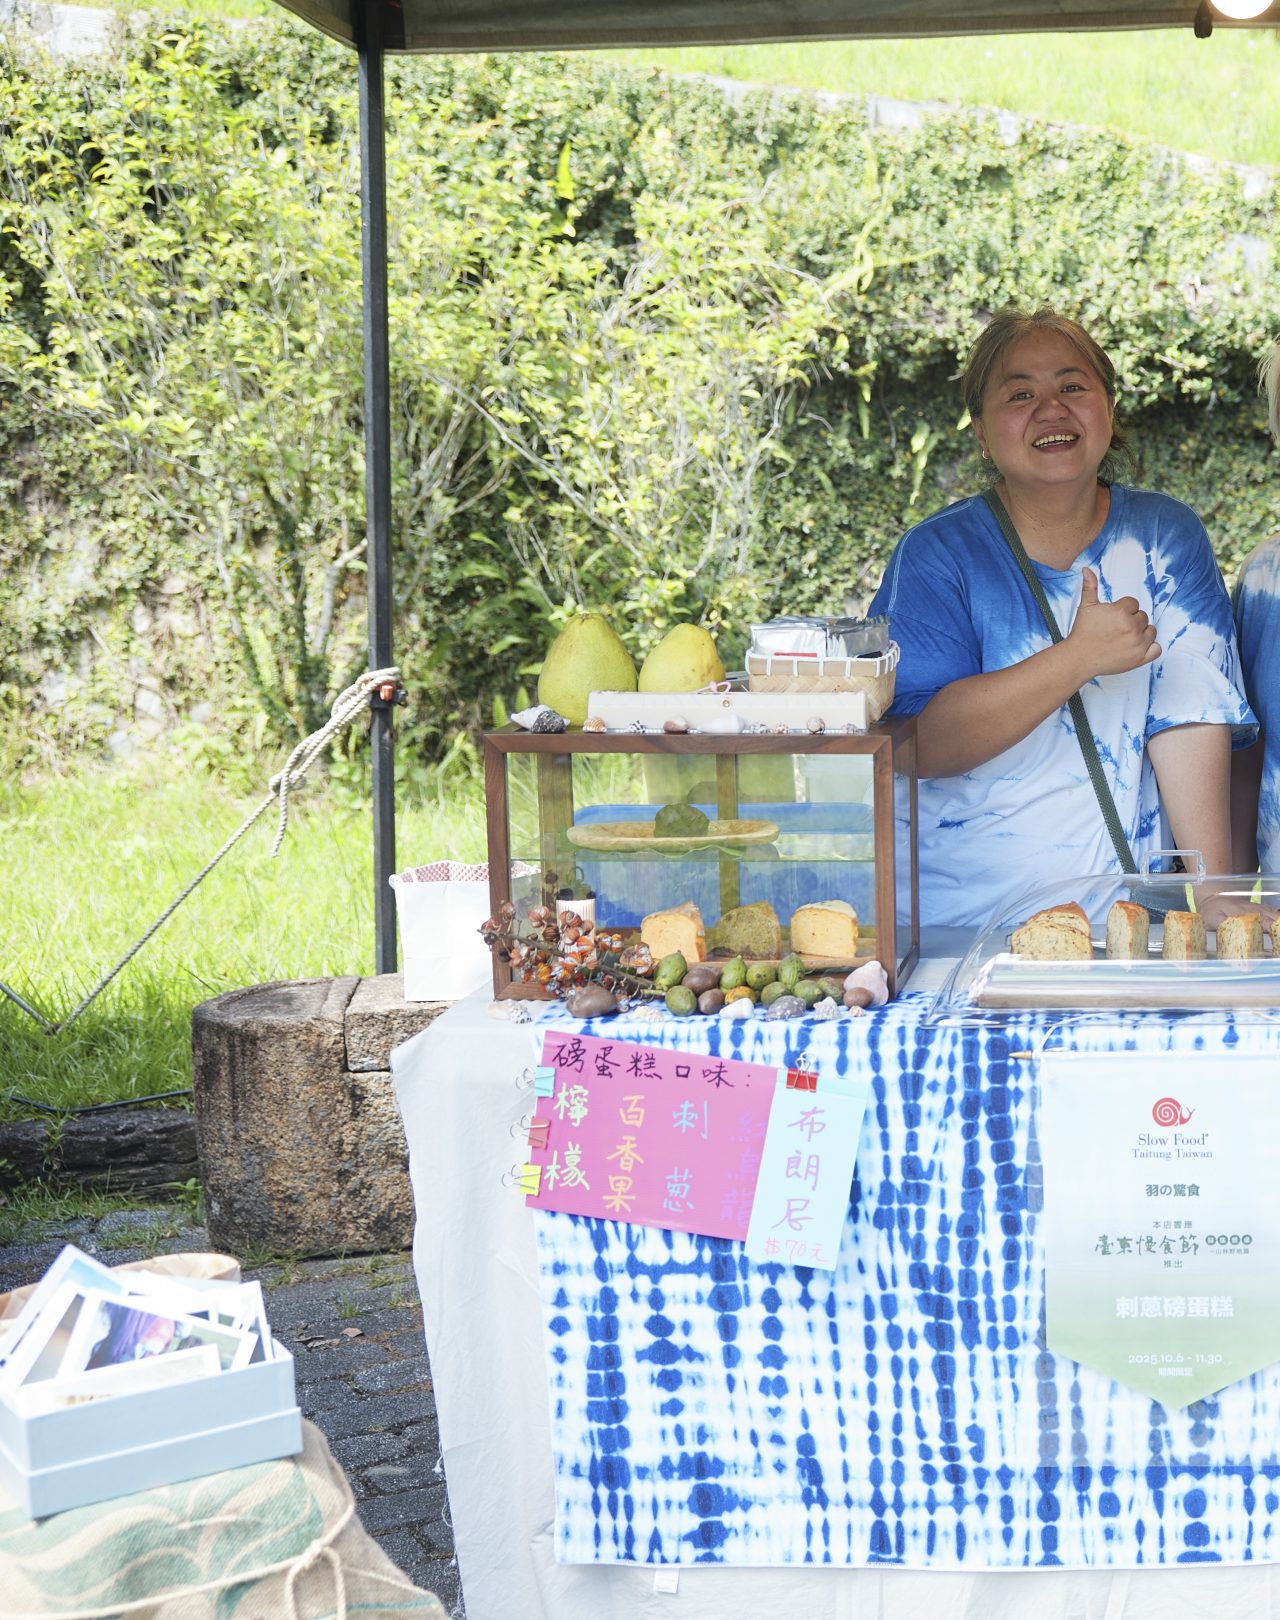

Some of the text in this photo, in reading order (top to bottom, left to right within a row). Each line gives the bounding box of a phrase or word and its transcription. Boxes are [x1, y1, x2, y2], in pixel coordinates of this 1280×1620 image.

[544, 1082, 591, 1191] 檸檬
[602, 1094, 646, 1213] 百香果
[1131, 1148, 1213, 1161] Taitung Taiwan
[1138, 1133, 1168, 1146] Slow
[771, 1106, 826, 1231] 布朗尼
[1195, 1354, 1223, 1365] 11.30
